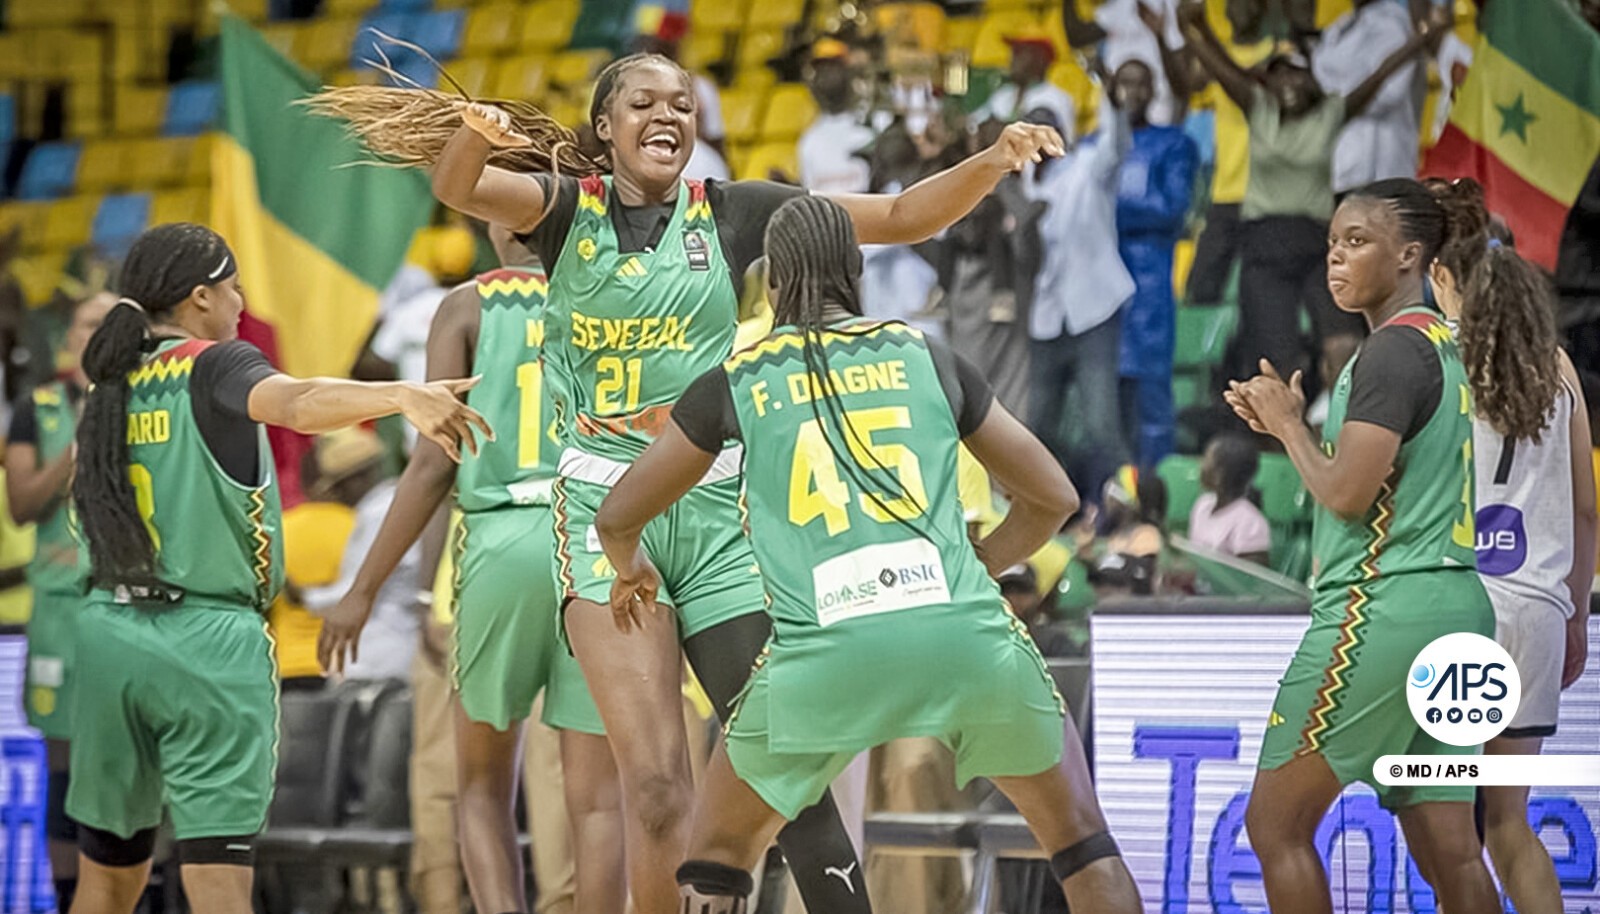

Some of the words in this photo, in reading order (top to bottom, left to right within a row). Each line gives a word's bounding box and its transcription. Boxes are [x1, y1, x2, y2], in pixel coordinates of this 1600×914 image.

[571, 311, 694, 351] SENEGAL
[594, 356, 642, 417] 21
[751, 380, 782, 418] F.
[787, 360, 910, 405] DIAGNE
[788, 406, 929, 537] 45
[898, 563, 939, 585] BSIC
